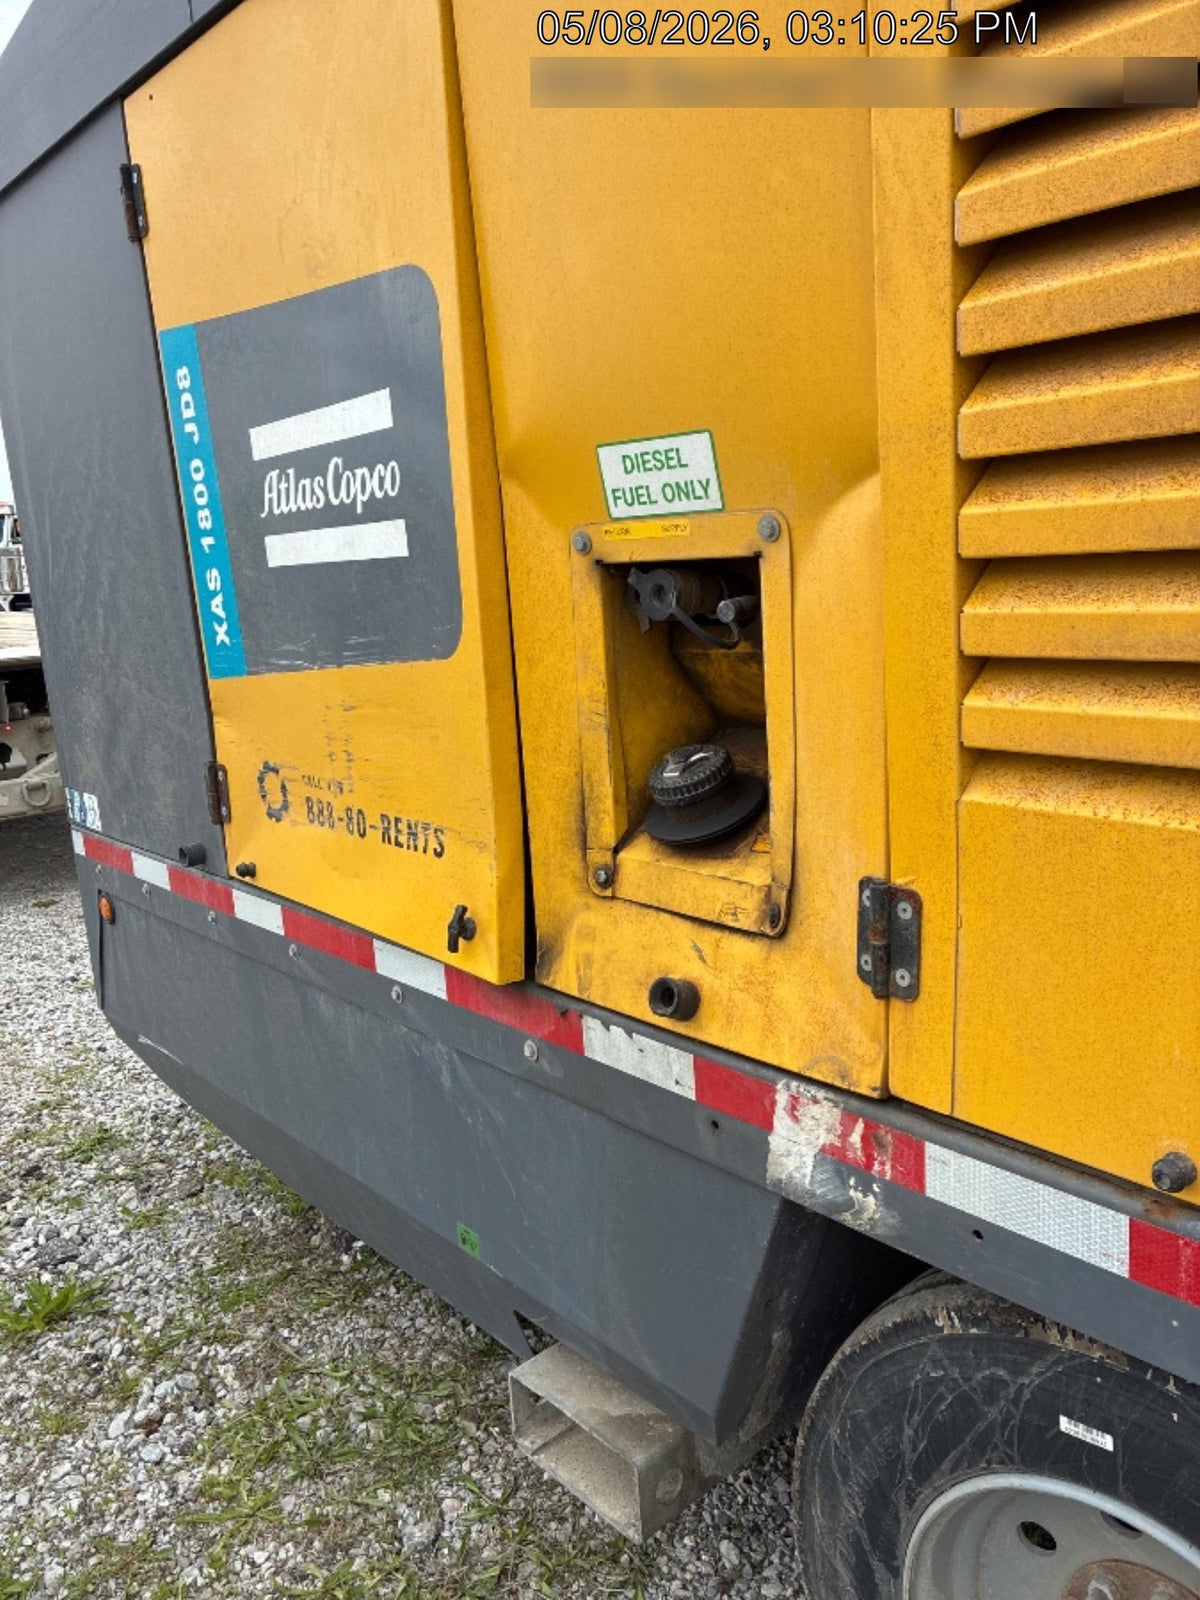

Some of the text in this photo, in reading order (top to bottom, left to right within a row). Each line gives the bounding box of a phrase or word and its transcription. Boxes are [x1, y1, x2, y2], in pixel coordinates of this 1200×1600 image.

[621, 447, 689, 475] DIESEL
[176, 366, 231, 646] XAS 1800 JD8
[611, 478, 711, 508] FUEL ONLY
